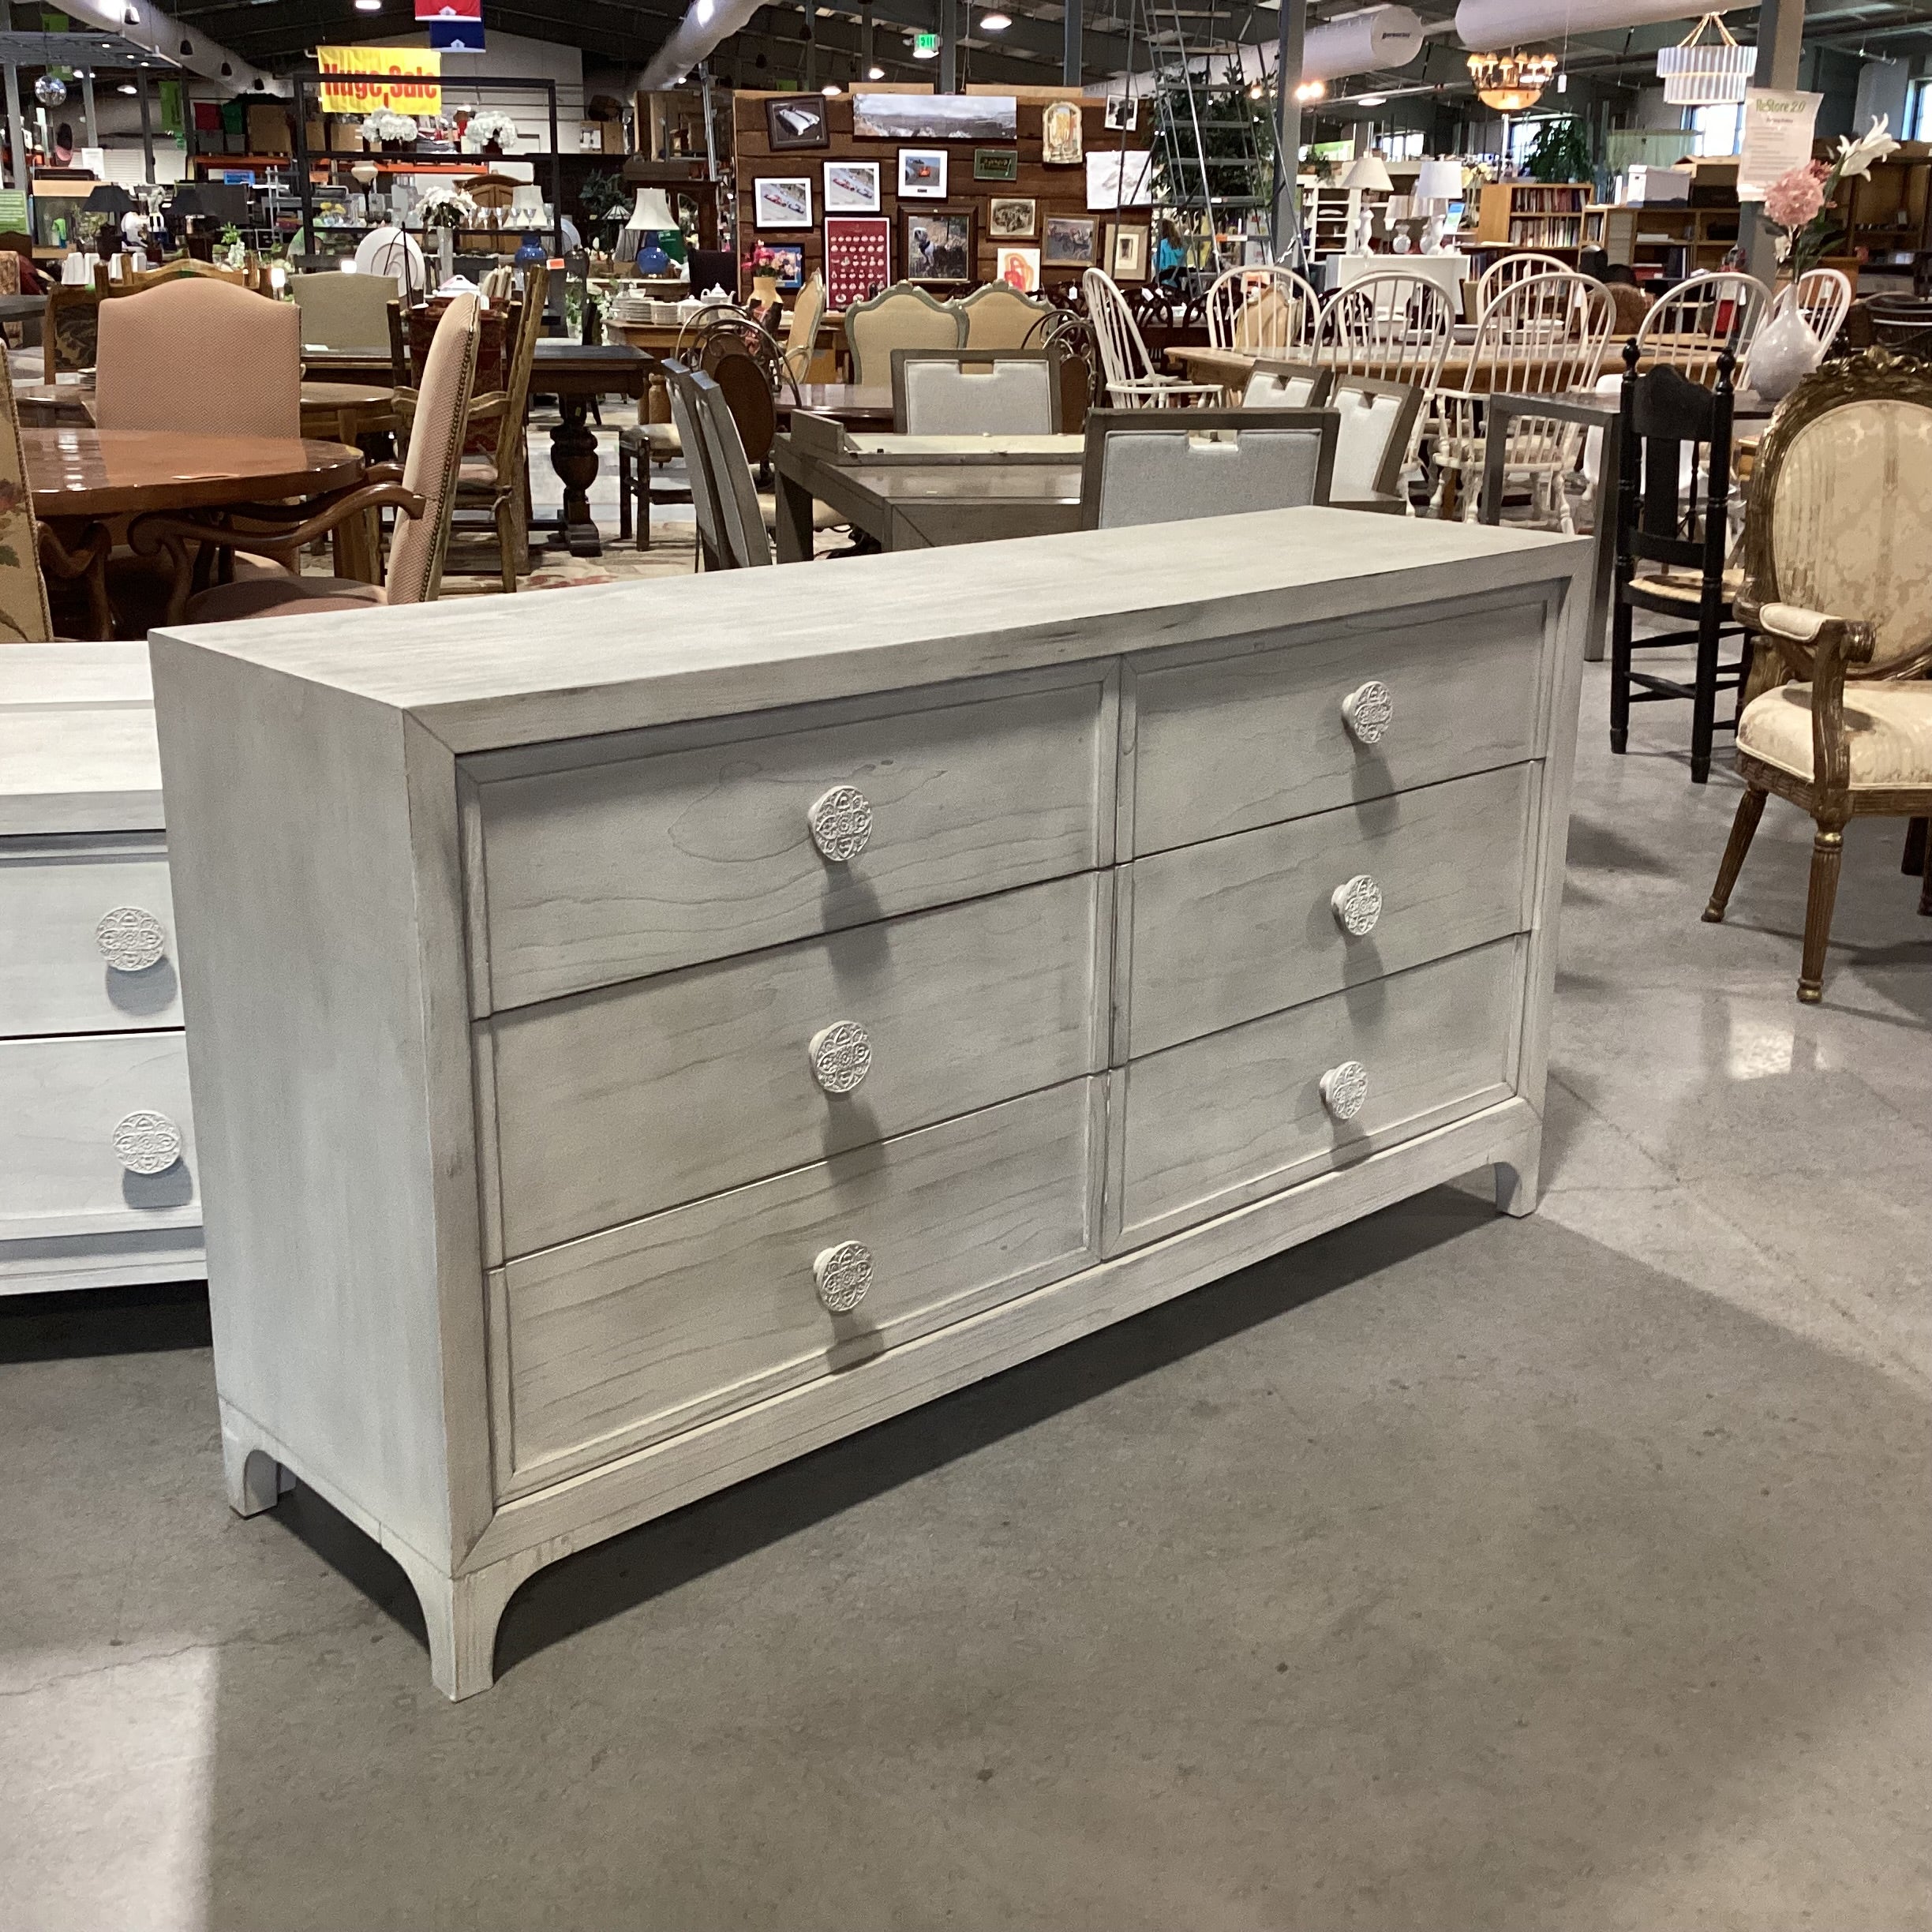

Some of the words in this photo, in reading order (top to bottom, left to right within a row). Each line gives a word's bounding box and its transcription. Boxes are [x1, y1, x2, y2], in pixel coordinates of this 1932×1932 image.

[324, 63, 382, 99] Huge
[389, 65, 437, 99] Sale
[1756, 99, 1789, 112] ReStore
